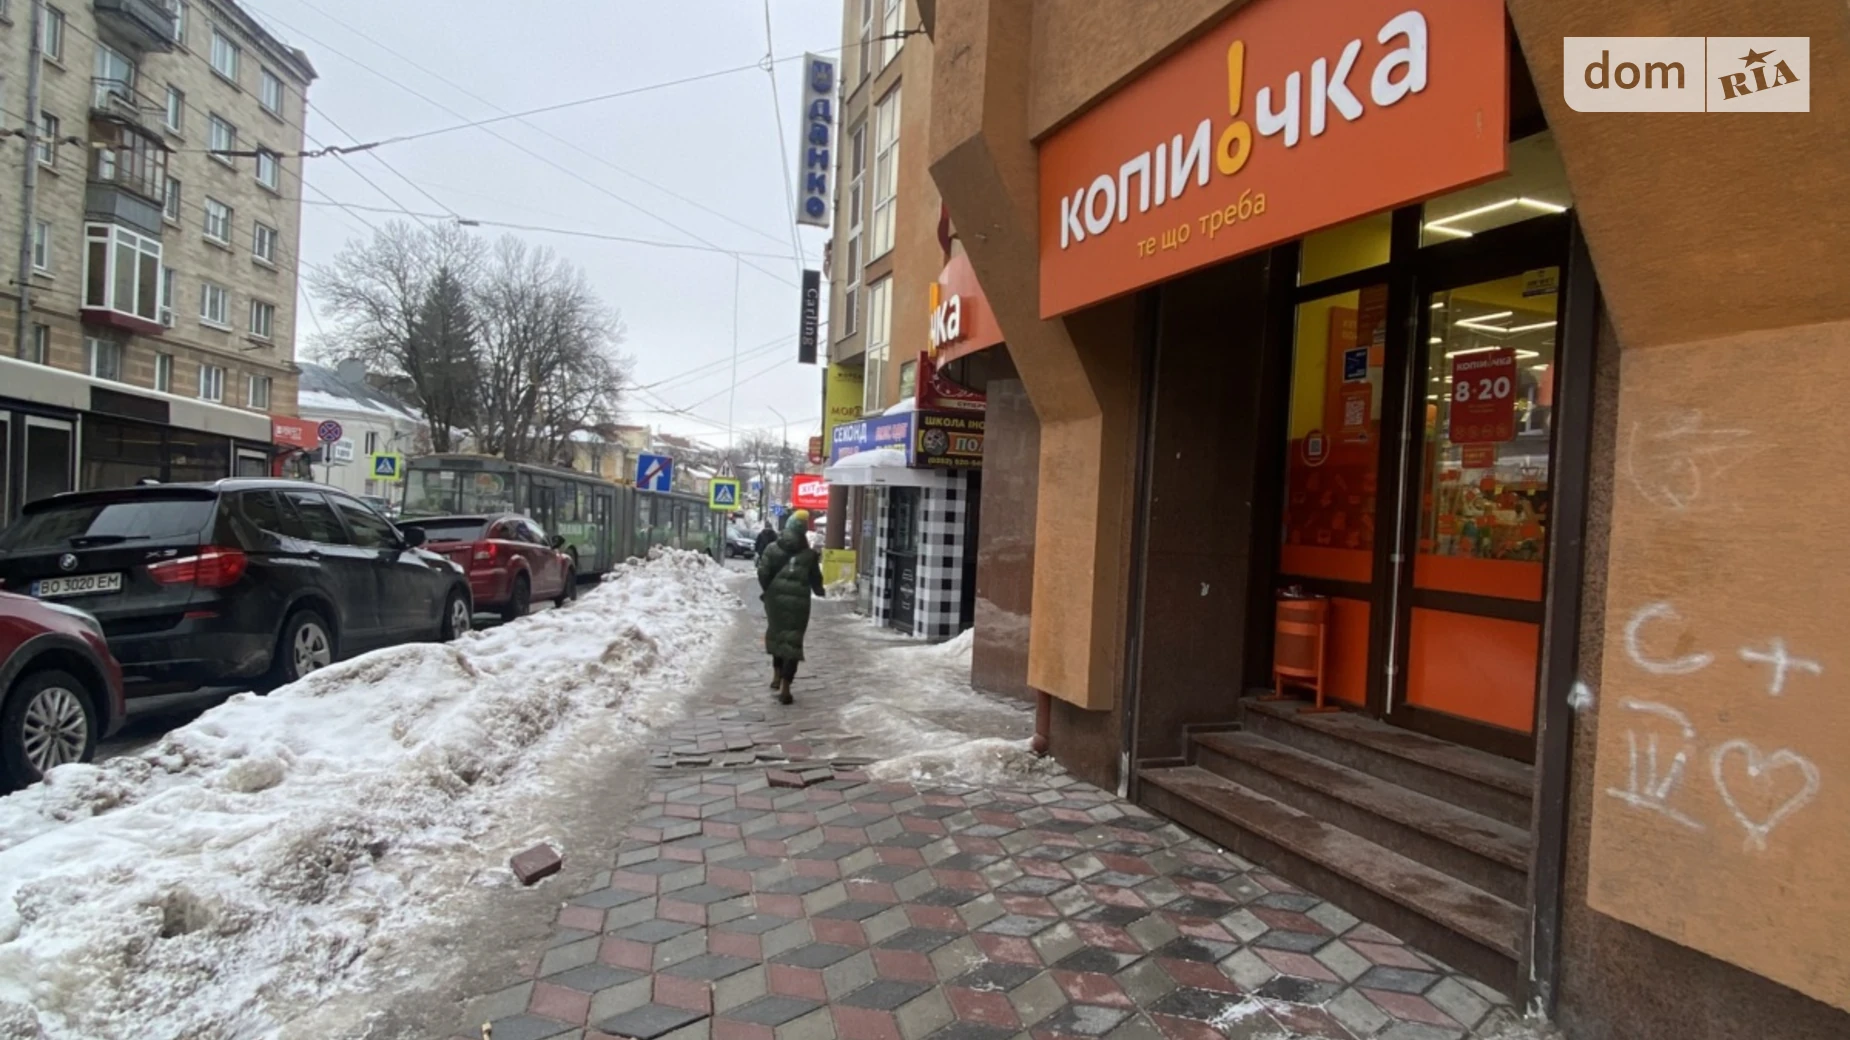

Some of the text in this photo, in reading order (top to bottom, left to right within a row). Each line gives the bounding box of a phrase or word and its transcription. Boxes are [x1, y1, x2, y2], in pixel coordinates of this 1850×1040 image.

[1137, 189, 1267, 259] те що треба
[834, 422, 867, 443] СЕКОНД
[925, 416, 966, 429] ШКОЛА
[40, 574, 120, 594] BO 3020 EM
